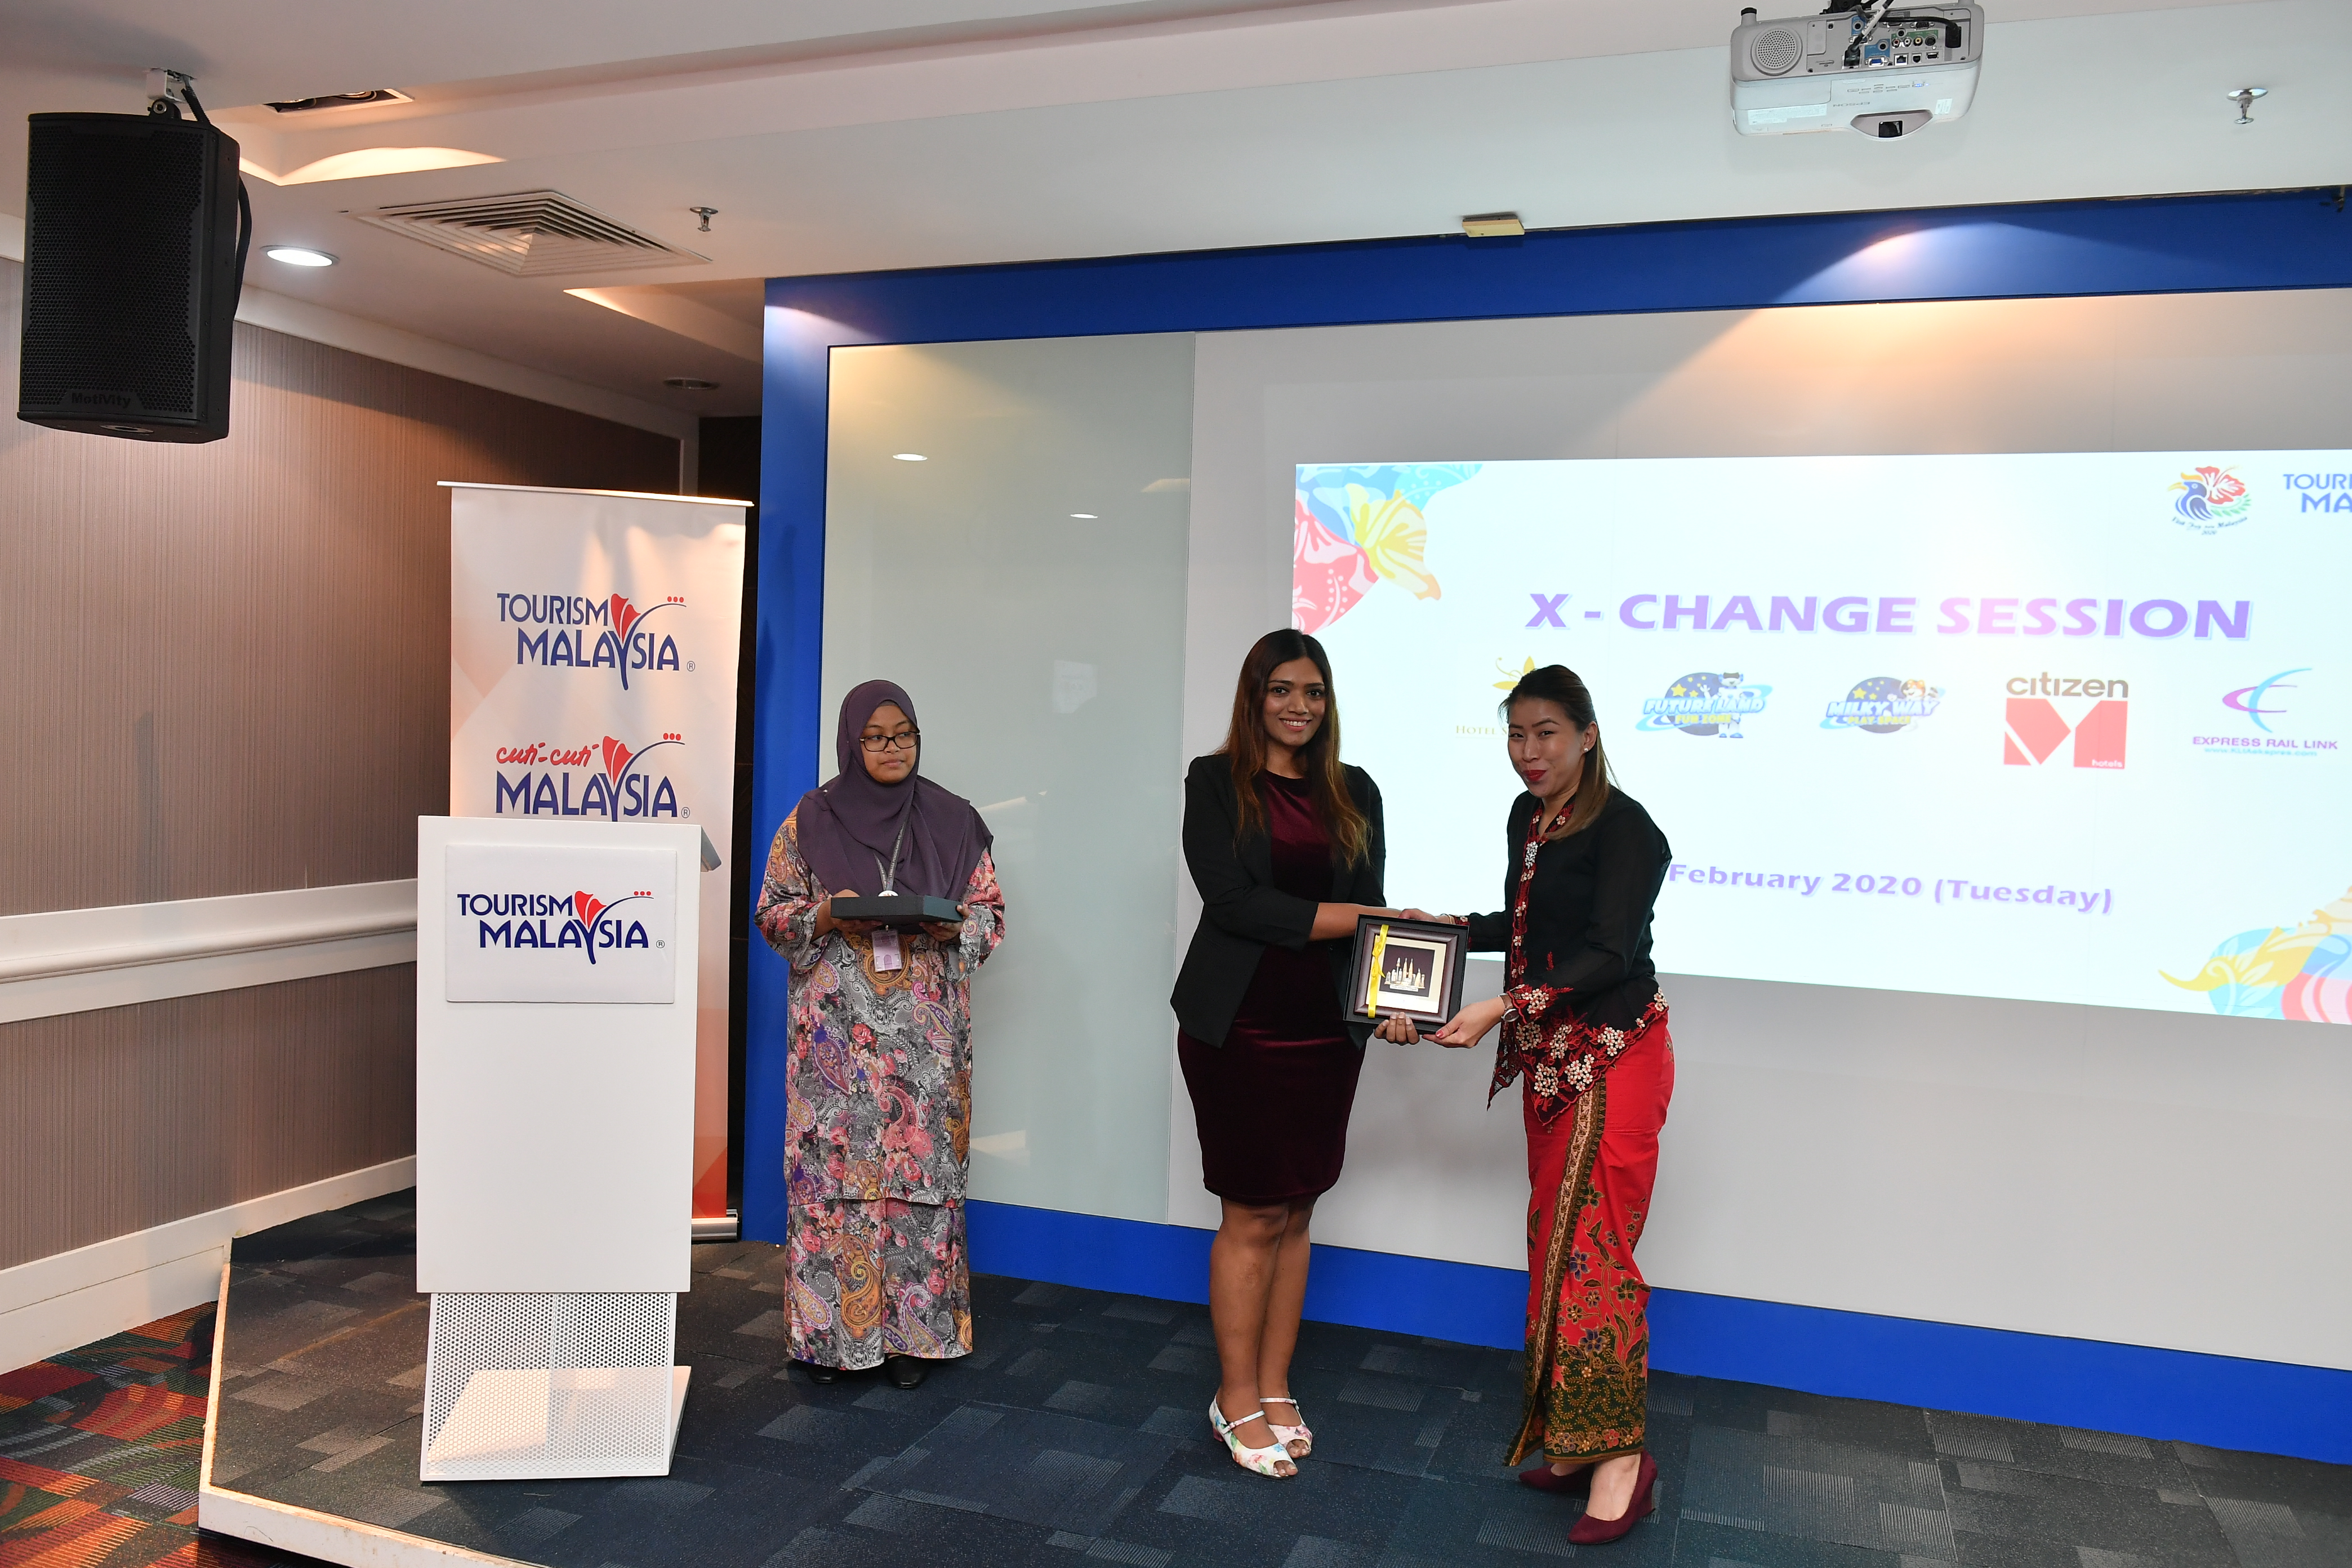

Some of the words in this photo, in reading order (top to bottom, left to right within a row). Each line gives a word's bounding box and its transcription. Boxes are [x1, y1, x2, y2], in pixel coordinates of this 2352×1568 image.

[71, 393, 131, 408] MotiVity
[497, 593, 608, 626] TOURISM
[1525, 593, 1571, 629] X
[1619, 594, 1919, 635] CHANGE
[1937, 596, 2251, 639] SESSION
[517, 628, 679, 691] MALAYSIA
[2007, 672, 2129, 698] citizen
[1643, 698, 1712, 714] FUTURE
[1713, 698, 1765, 714] LAND
[1827, 701, 1890, 717] MILKY
[1892, 701, 1940, 716] WAY
[496, 742, 600, 766] cuti-cuti
[2193, 736, 2261, 747] EXPRESS
[2266, 739, 2299, 748] RAIL
[2304, 740, 2338, 750] LINK
[2092, 759, 2123, 768] hotels
[496, 770, 678, 822] MALAYSIA
[1669, 864, 1821, 895] February
[1832, 872, 1922, 896] 2020
[1934, 878, 2114, 914] (Tuesday)
[457, 893, 573, 916] TOURISM
[479, 919, 649, 964] MALAYSIA
